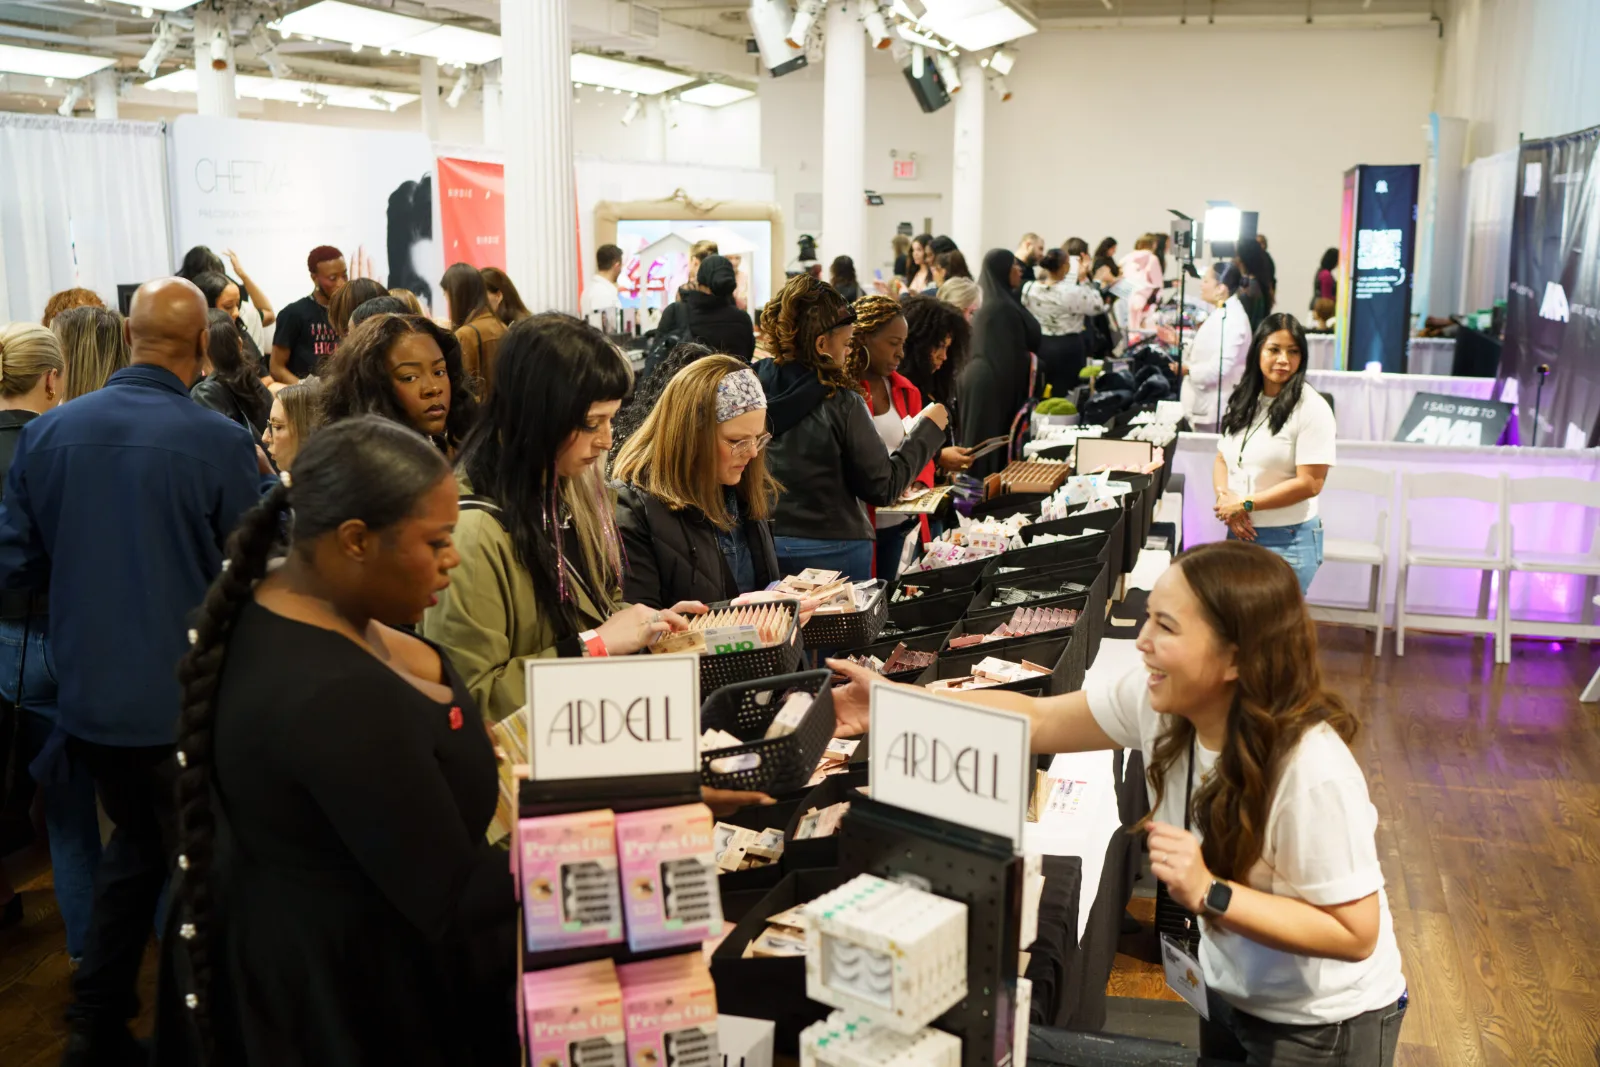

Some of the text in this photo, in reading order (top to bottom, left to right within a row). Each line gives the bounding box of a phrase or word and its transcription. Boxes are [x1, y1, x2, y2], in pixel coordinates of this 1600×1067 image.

[1423, 401, 1497, 419] I SAID YES TO
[546, 695, 682, 746] ARDELL
[884, 731, 1009, 804] ARDELL
